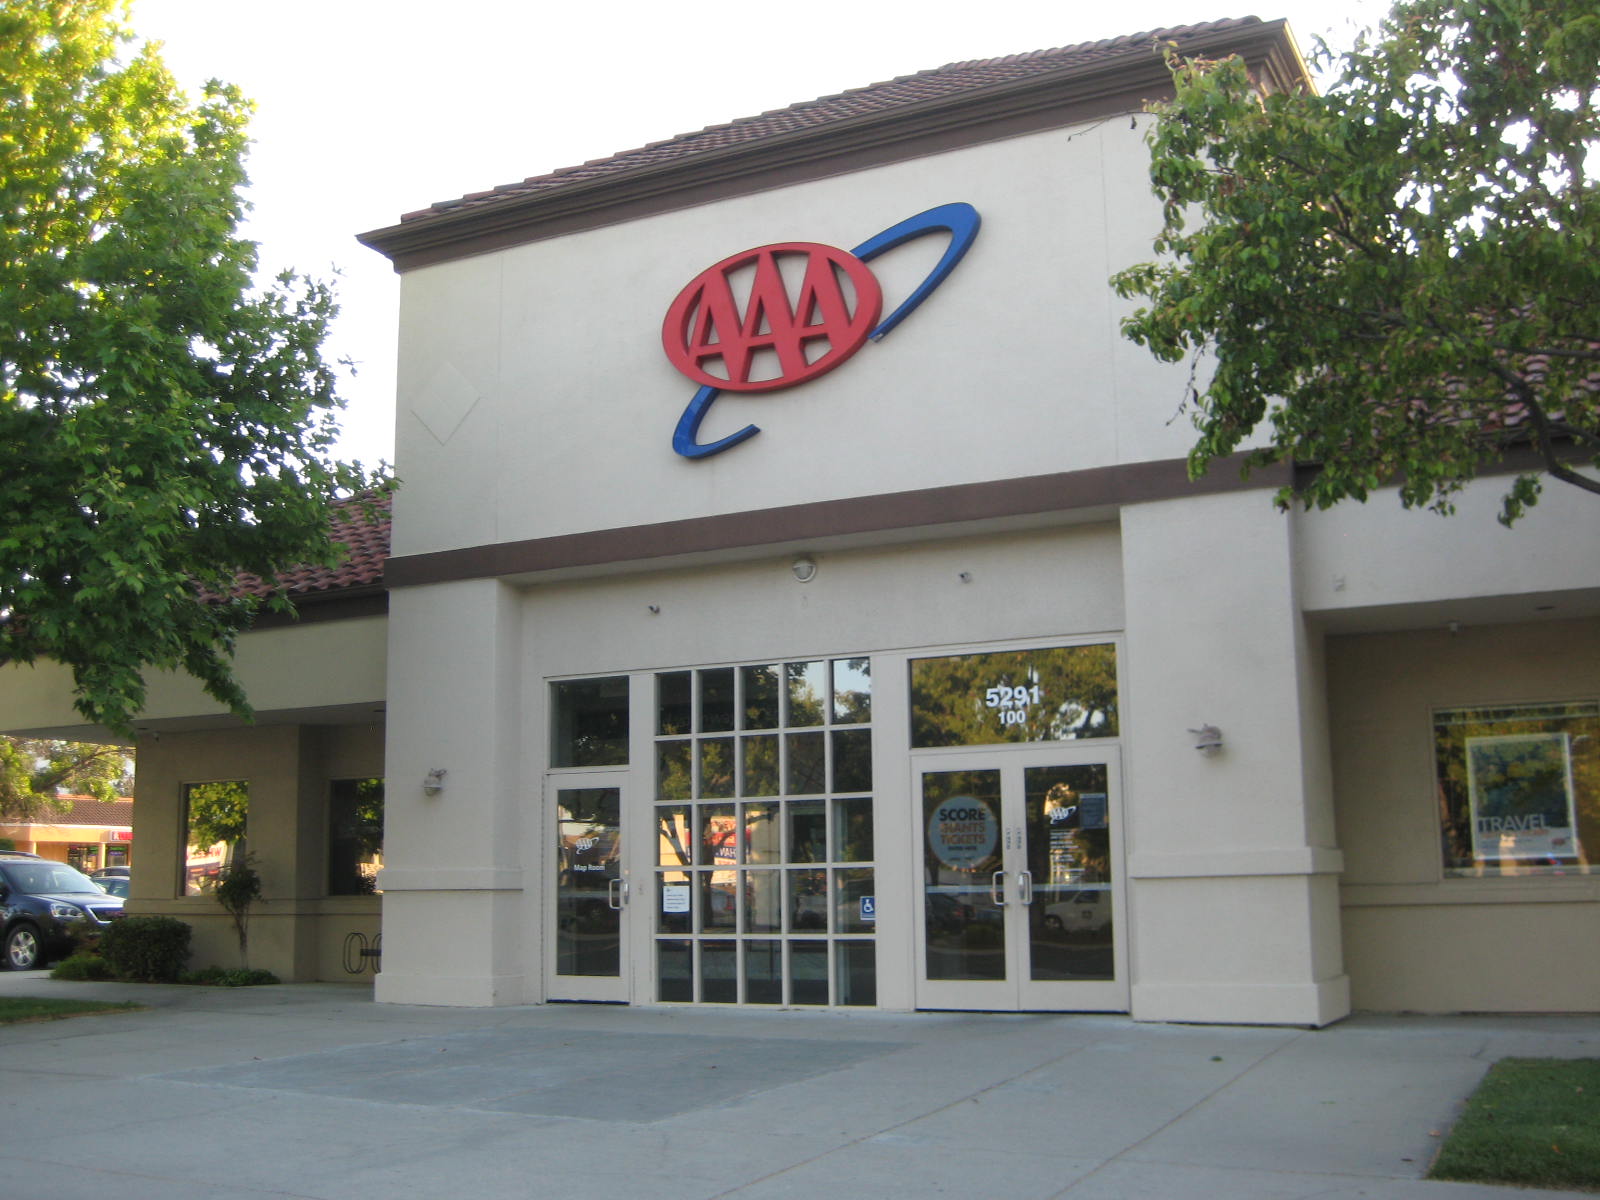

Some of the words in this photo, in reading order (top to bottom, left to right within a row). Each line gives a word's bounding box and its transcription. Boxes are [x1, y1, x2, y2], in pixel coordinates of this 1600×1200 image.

[667, 242, 874, 391] AAA
[986, 685, 1040, 708] 5291
[998, 710, 1026, 725] 100
[939, 807, 986, 821] SCORE
[1477, 814, 1550, 833] TRAVEL
[573, 864, 587, 872] Map
